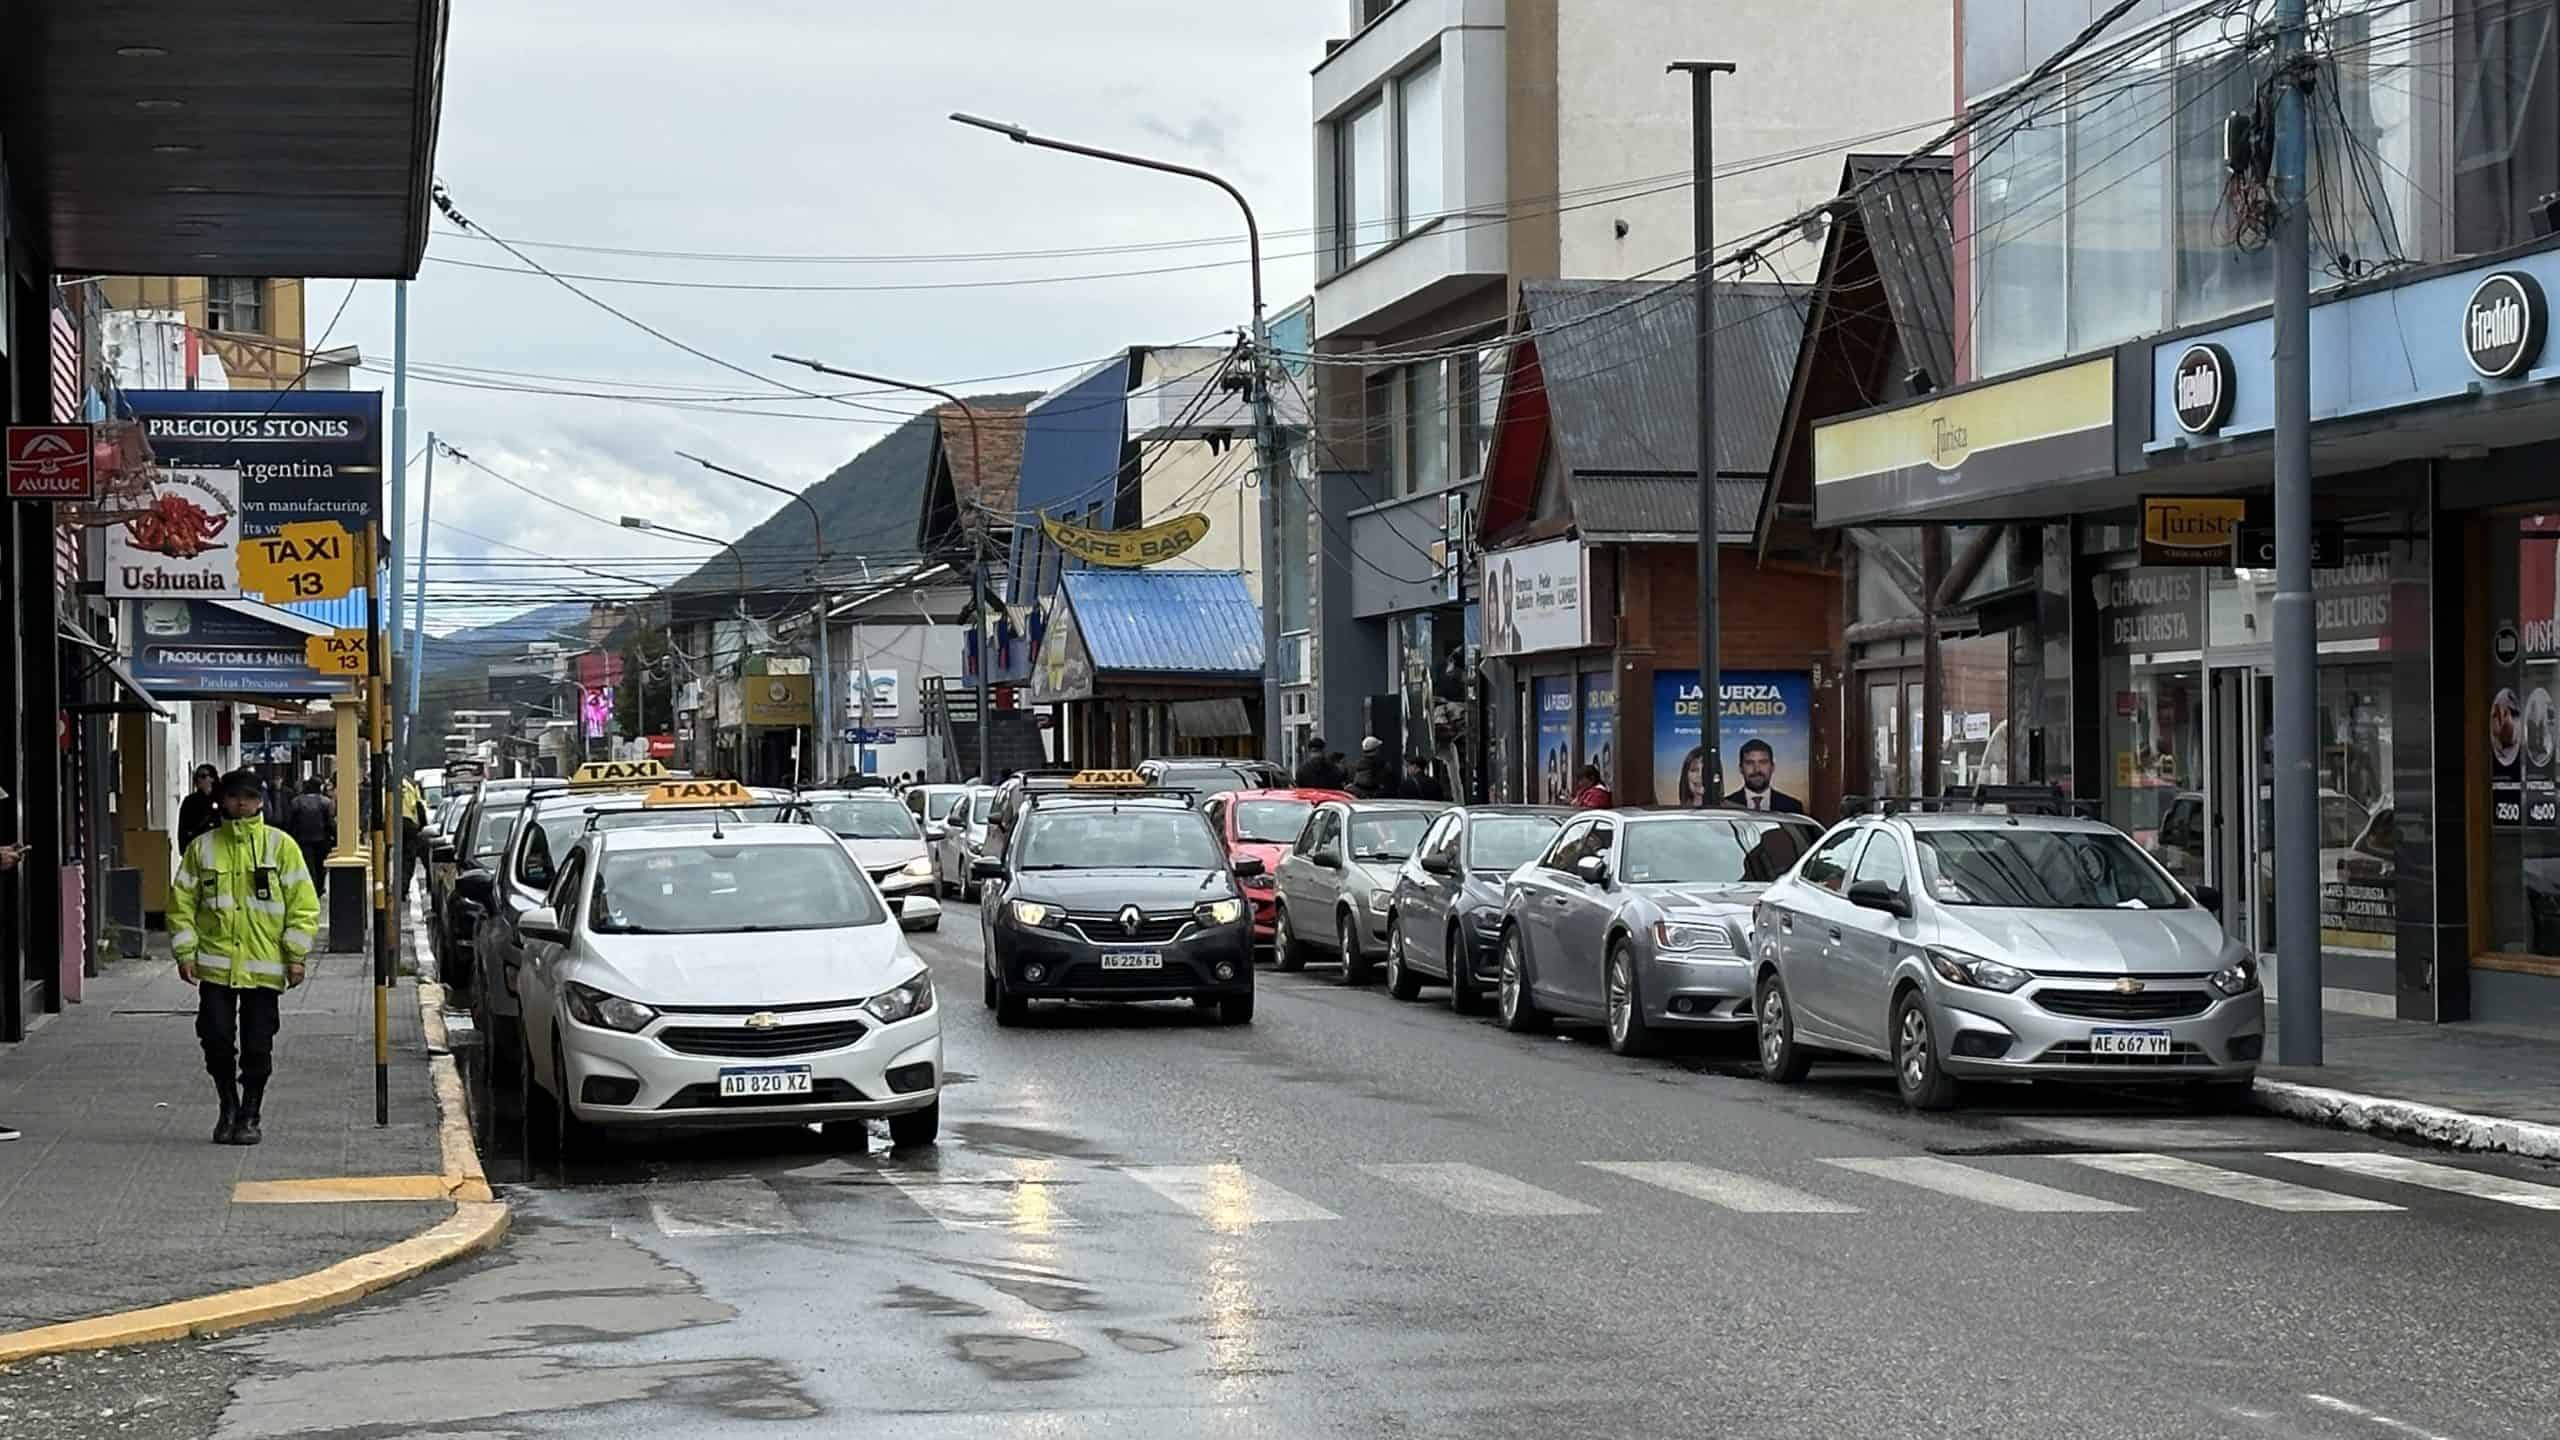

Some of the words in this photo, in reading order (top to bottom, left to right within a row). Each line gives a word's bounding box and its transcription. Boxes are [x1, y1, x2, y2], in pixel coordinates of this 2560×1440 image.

[2472, 296, 2520, 352] freddo
[2178, 364, 2214, 411] freddo
[149, 420, 257, 437] PRECIOUS
[264, 420, 348, 437] STONES
[234, 458, 333, 483] Argentina
[260, 537, 340, 564] TAXI
[1055, 528, 1121, 558] CAFE
[1140, 528, 1195, 558] BAR
[120, 566, 226, 591] Ushuaia
[288, 572, 324, 596] 13
[2112, 575, 2191, 608] CHOCOLATES
[2113, 612, 2188, 643] DELTURISTA
[324, 638, 367, 653] TAX
[159, 649, 263, 665] PRODUCTORES
[338, 656, 360, 669] 13
[1679, 685, 1704, 700] LA
[1719, 685, 1782, 700] UERZA
[1674, 701, 1702, 716] DE
[583, 762, 658, 779] TAXI
[1081, 771, 1133, 782] TAXI
[660, 782, 738, 798] TAXI
[1121, 956, 1142, 967] 226
[2095, 1036, 2113, 1052] AE
[2118, 1036, 2144, 1052] 667
[2150, 1037, 2168, 1053] YM
[726, 1076, 745, 1093] AD
[751, 1075, 781, 1092] 820
[788, 1074, 807, 1091] XZ
